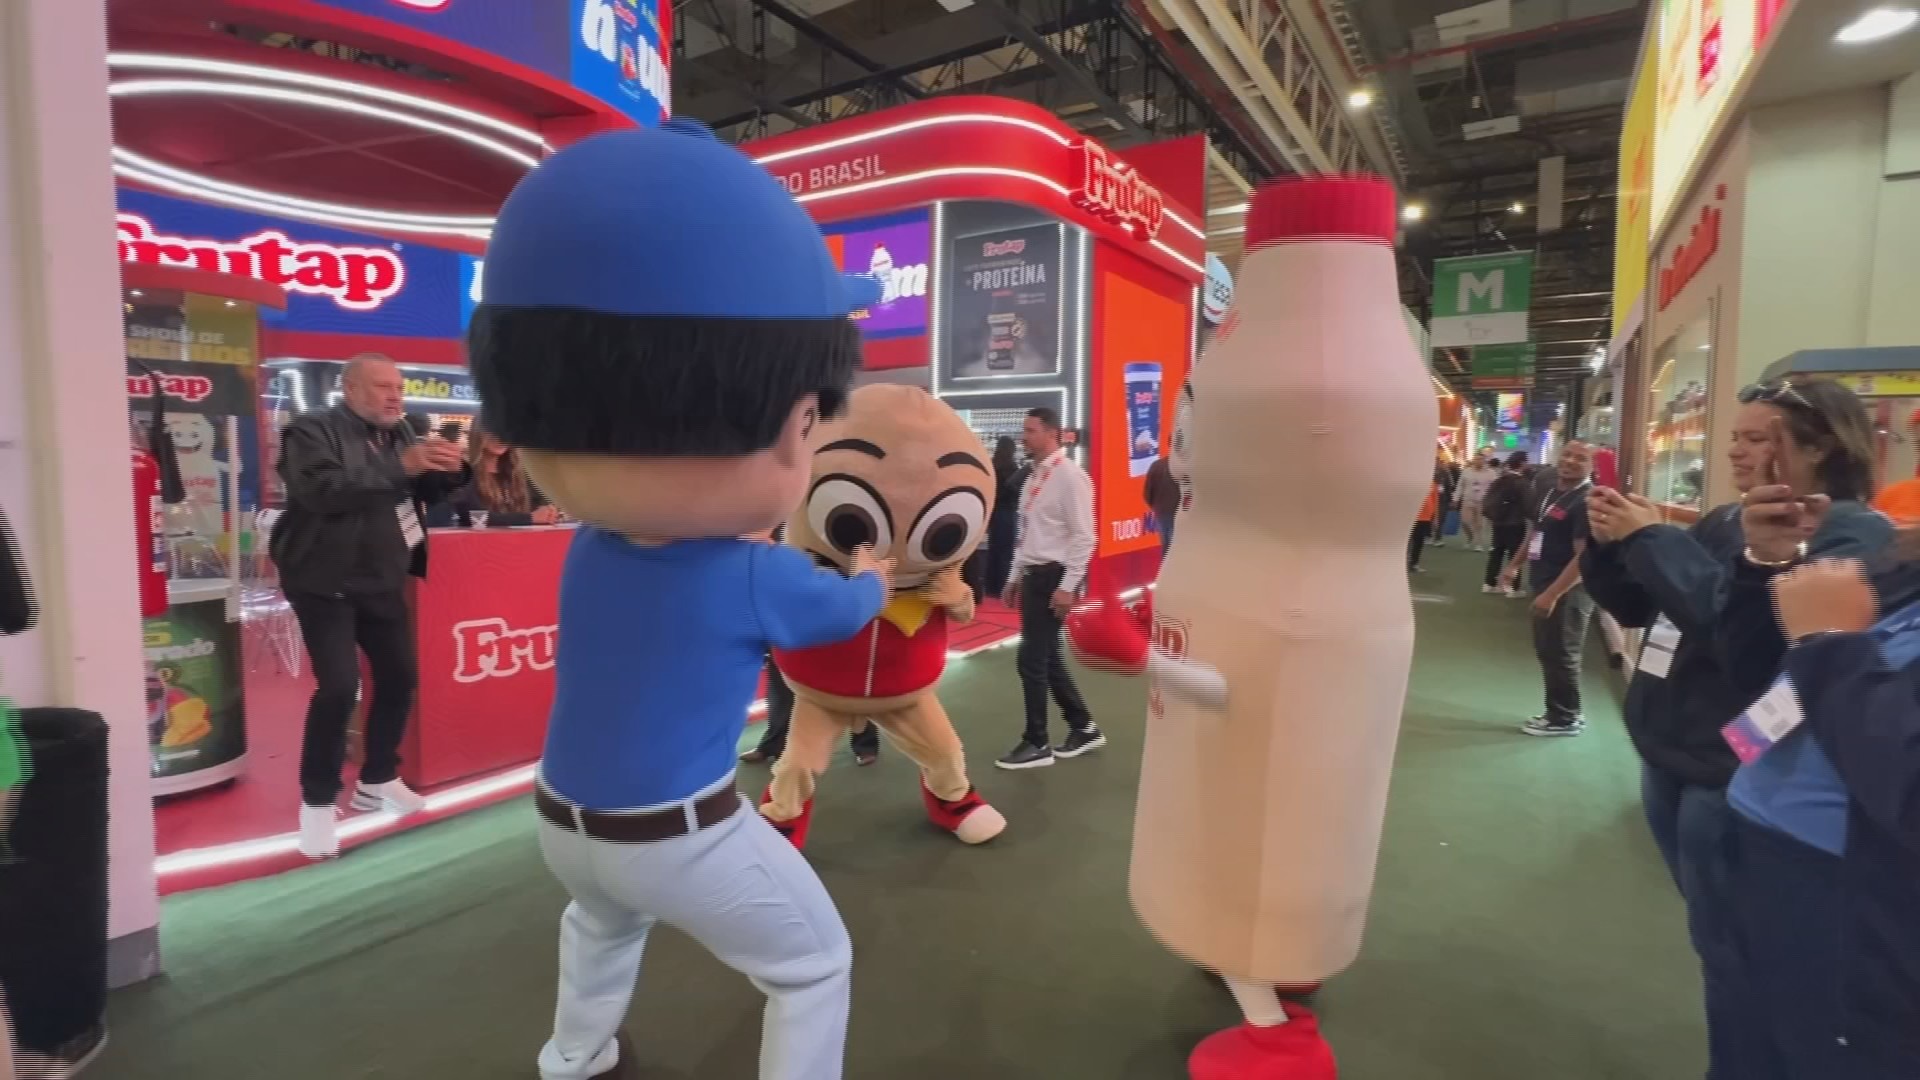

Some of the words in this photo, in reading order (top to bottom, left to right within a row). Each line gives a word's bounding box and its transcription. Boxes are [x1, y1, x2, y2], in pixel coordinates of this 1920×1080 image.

[810, 154, 886, 189] BRASIL
[1084, 138, 1162, 238] Frutap
[973, 261, 1046, 291] PROTEÍNA
[1457, 269, 1505, 312] M
[130, 324, 195, 344] SHOW
[198, 331, 224, 345] DE
[1111, 517, 1142, 541] TUDO
